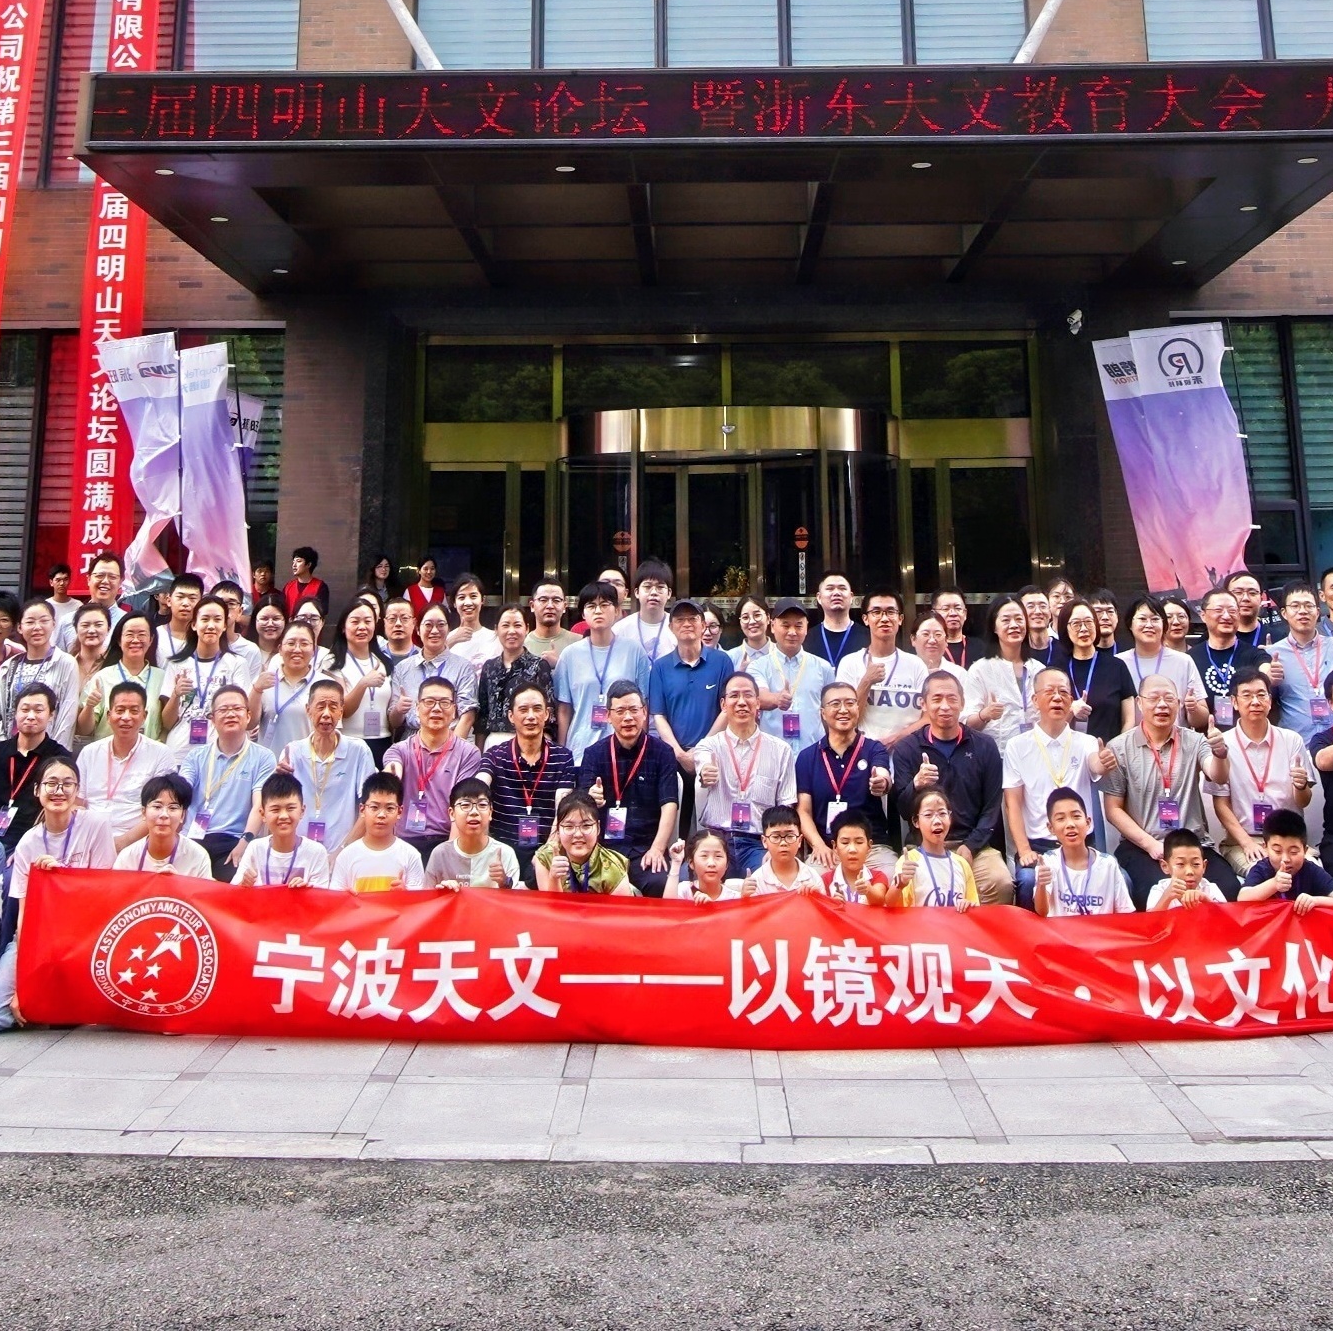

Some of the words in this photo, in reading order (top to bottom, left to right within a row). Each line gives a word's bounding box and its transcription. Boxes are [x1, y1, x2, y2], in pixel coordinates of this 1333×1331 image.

[79, 181, 129, 574] 届四明山天论坛圆满成
[187, 933, 214, 1006] ASSOCIATION
